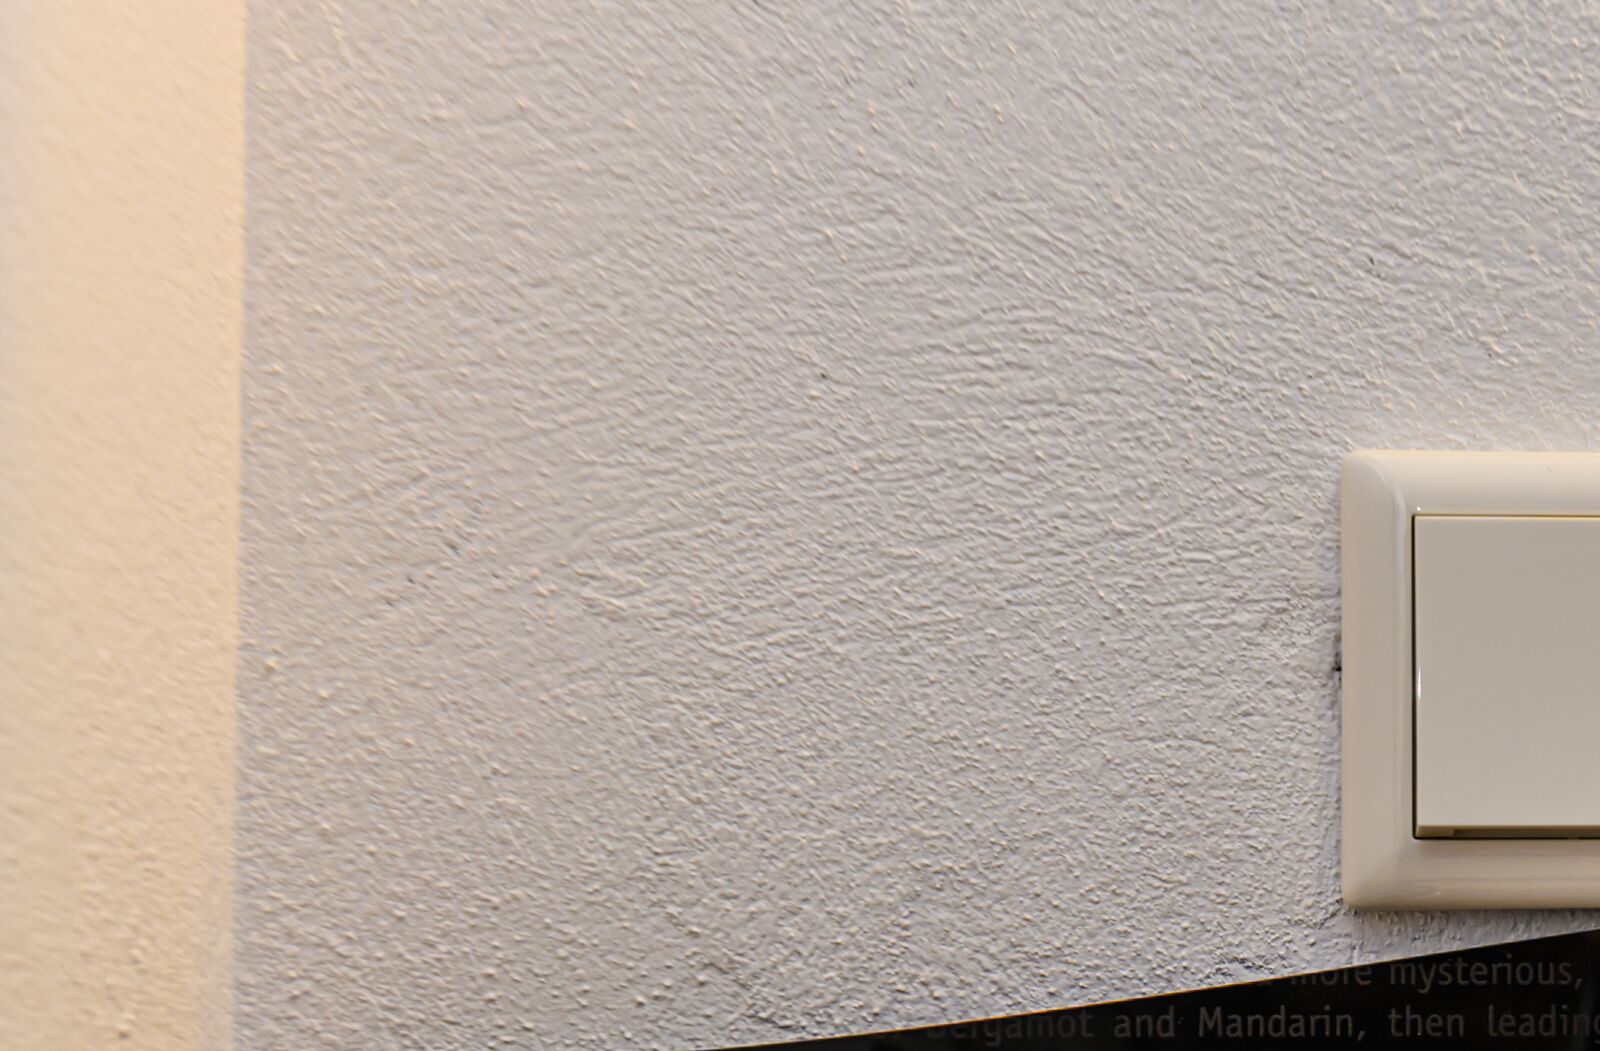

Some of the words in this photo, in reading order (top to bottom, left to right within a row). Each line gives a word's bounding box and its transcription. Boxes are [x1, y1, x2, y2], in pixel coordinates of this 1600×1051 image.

[1390, 953, 1583, 993] mysterious,
[1113, 1005, 1176, 1039] and
[1198, 1005, 1367, 1043] Mandarin,
[1387, 1005, 1466, 1037] then
